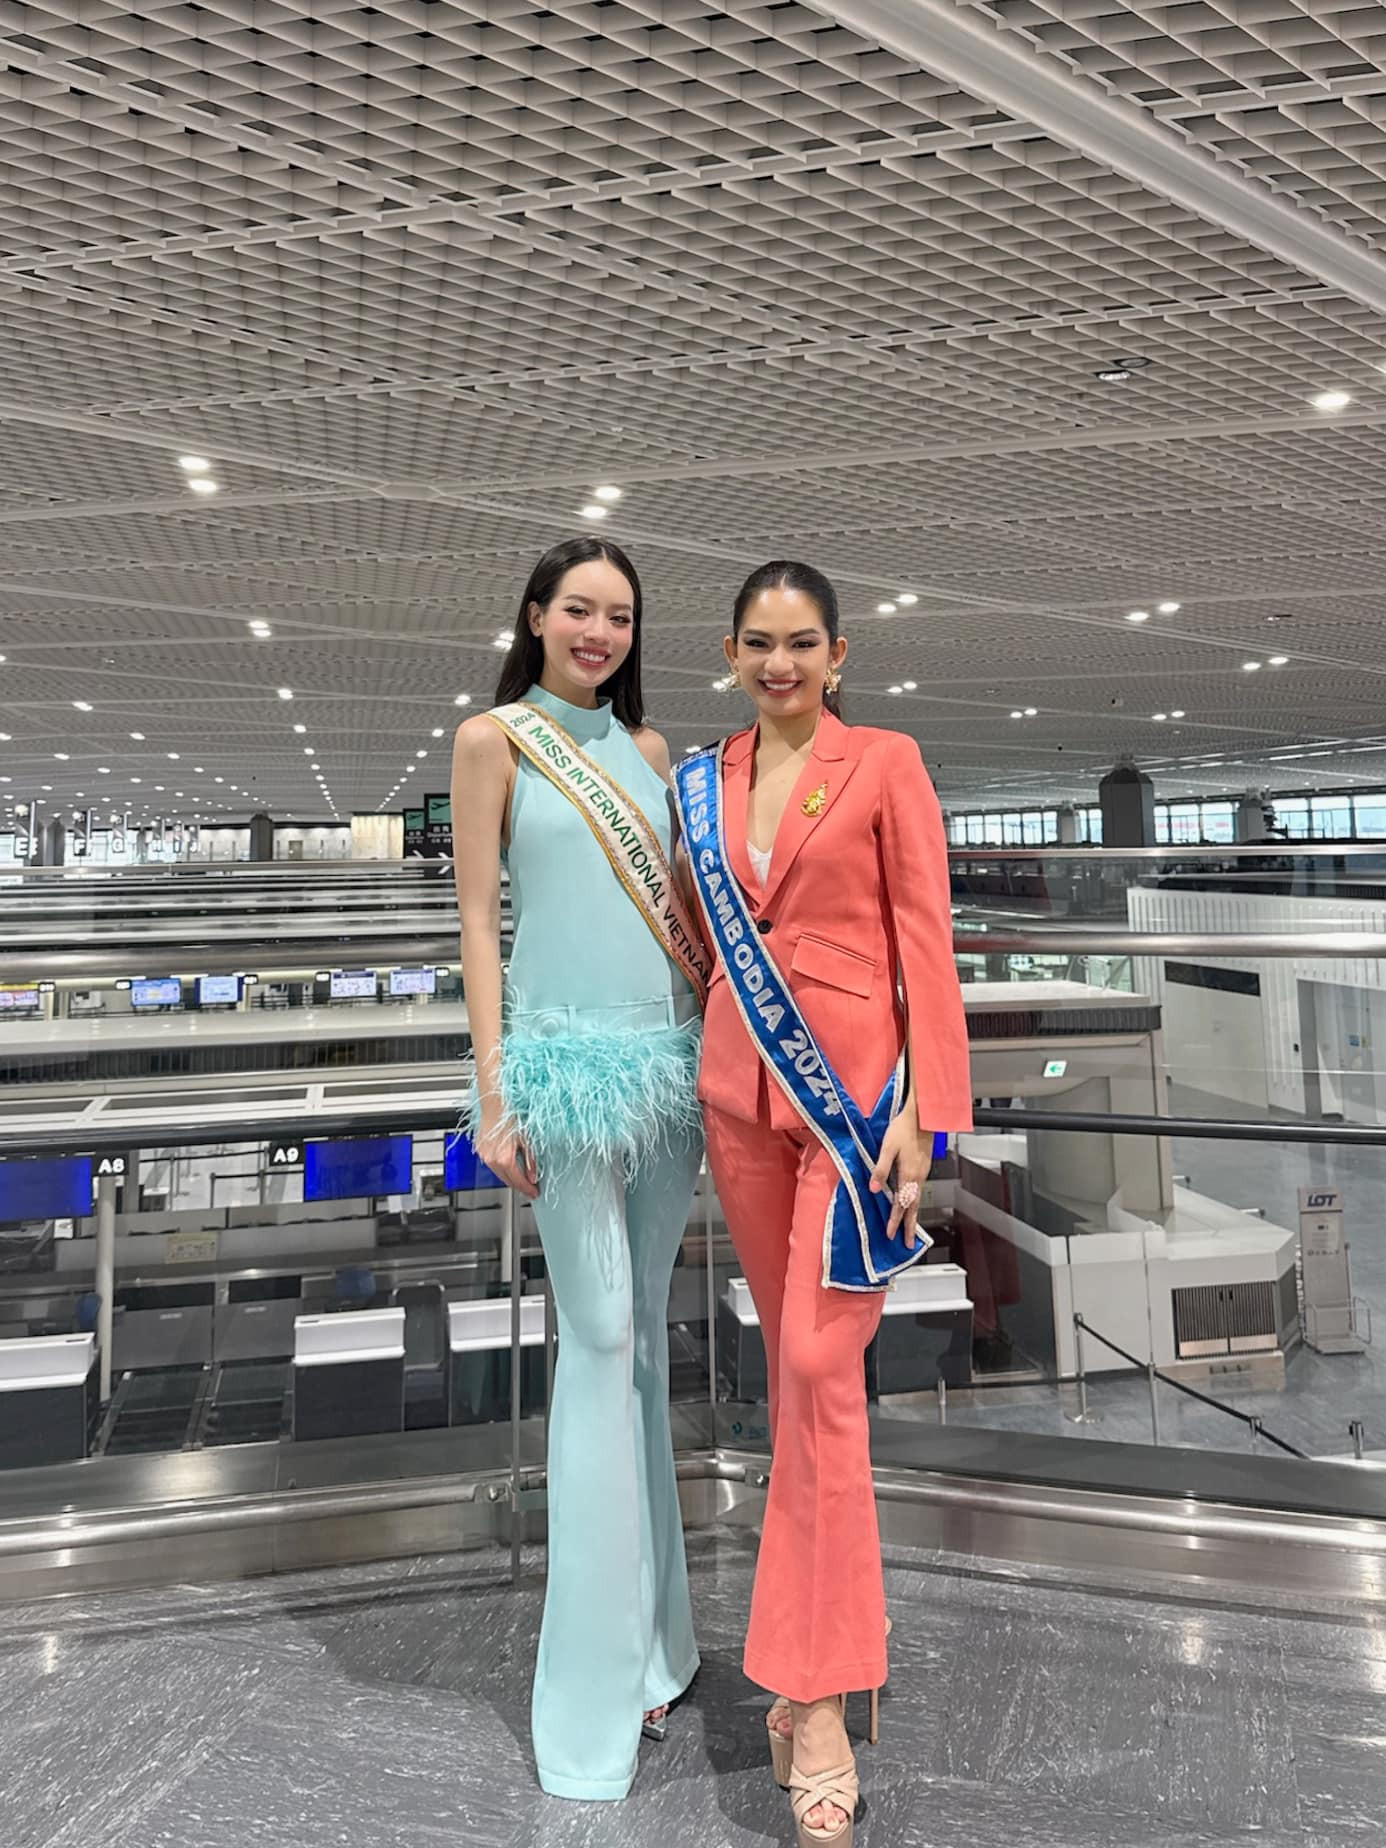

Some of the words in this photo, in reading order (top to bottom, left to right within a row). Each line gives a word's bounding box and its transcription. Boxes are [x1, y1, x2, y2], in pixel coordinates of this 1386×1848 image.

[509, 712, 536, 728] 2024
[527, 725, 572, 769] MISS
[566, 767, 666, 908] INTERNATIONAL
[15, 837, 28, 856] E
[685, 767, 711, 843] MISS
[699, 850, 786, 1034] CAMBODIA
[273, 1147, 299, 1163] A9
[98, 1158, 125, 1174] A8
[1307, 1194, 1338, 1207] LOT
